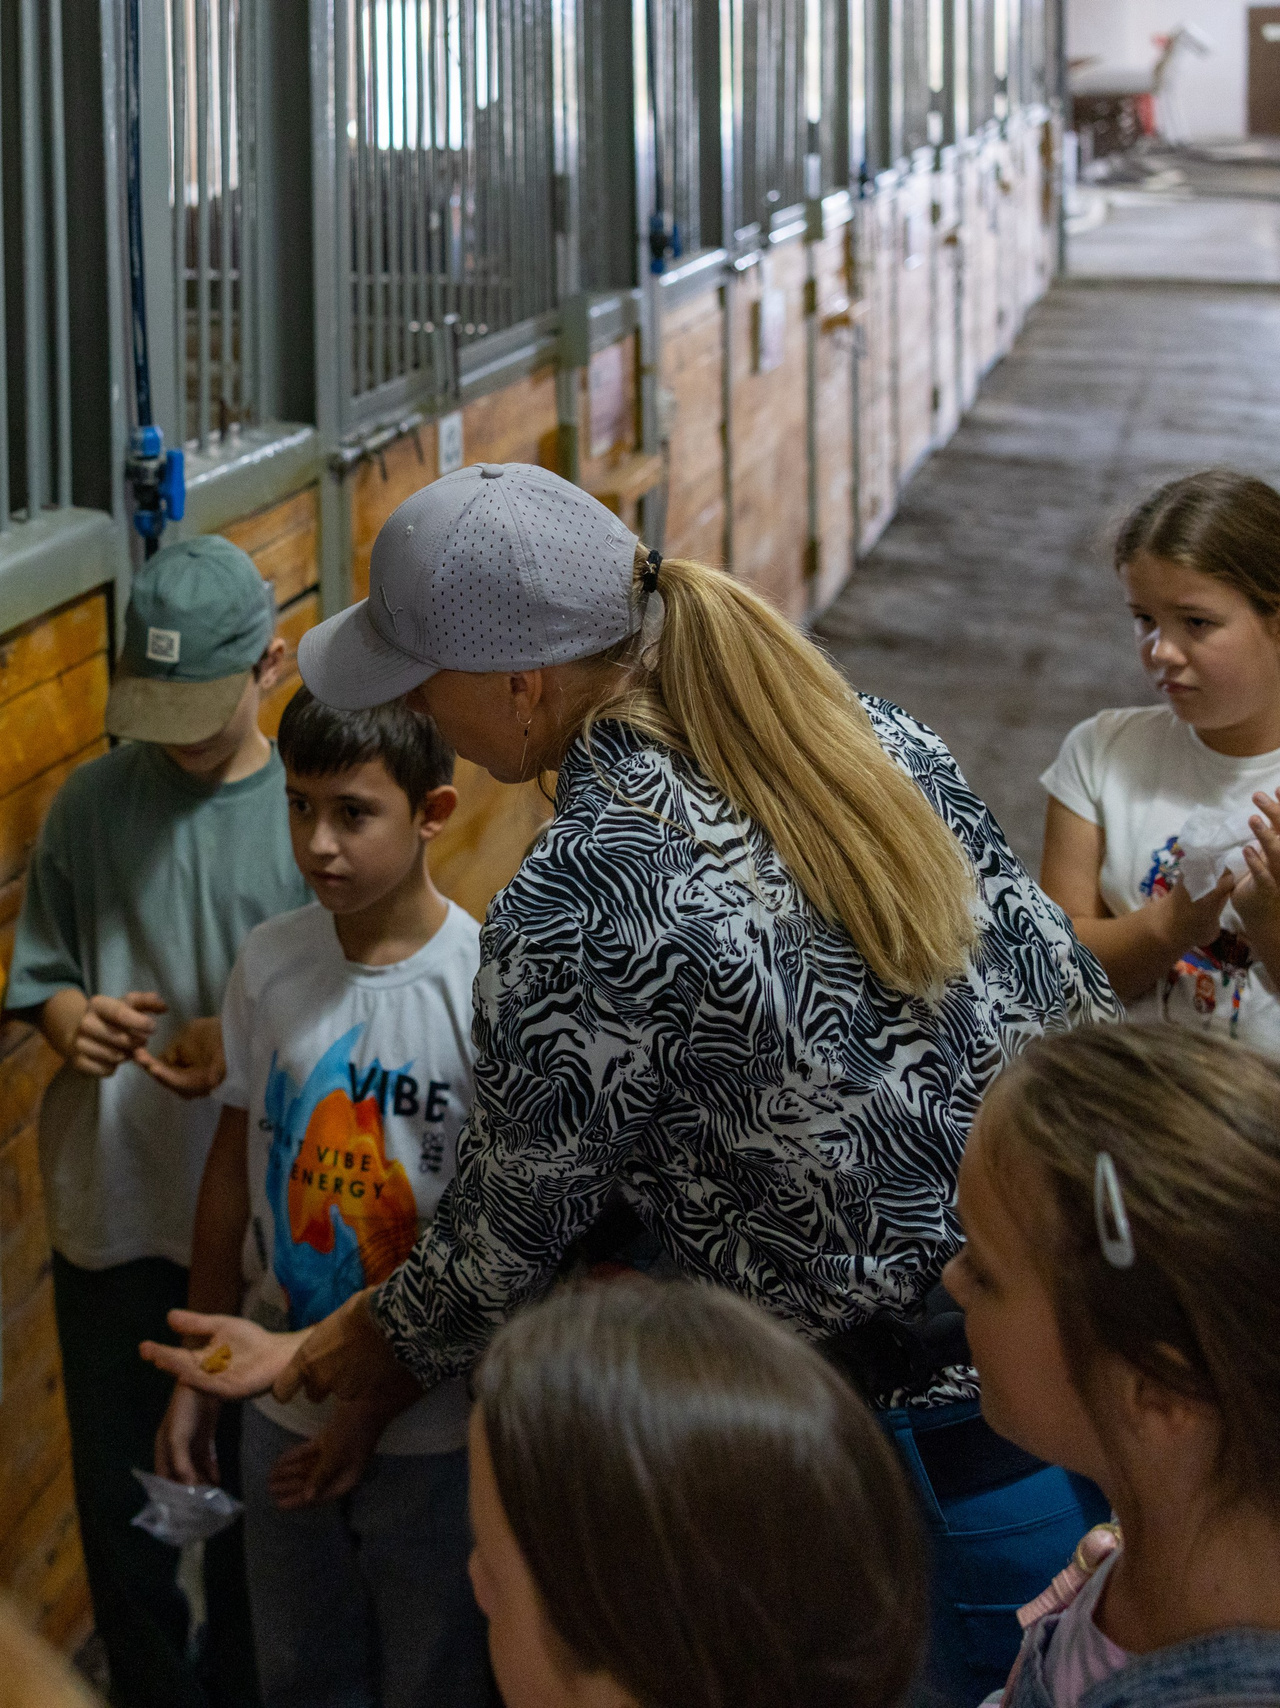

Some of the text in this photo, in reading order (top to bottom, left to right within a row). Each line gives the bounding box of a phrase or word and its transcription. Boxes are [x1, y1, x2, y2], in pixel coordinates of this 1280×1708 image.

[348, 1062, 451, 1123] VIBE
[316, 1145, 372, 1172] VIBE
[291, 1162, 384, 1200] ENERGY
